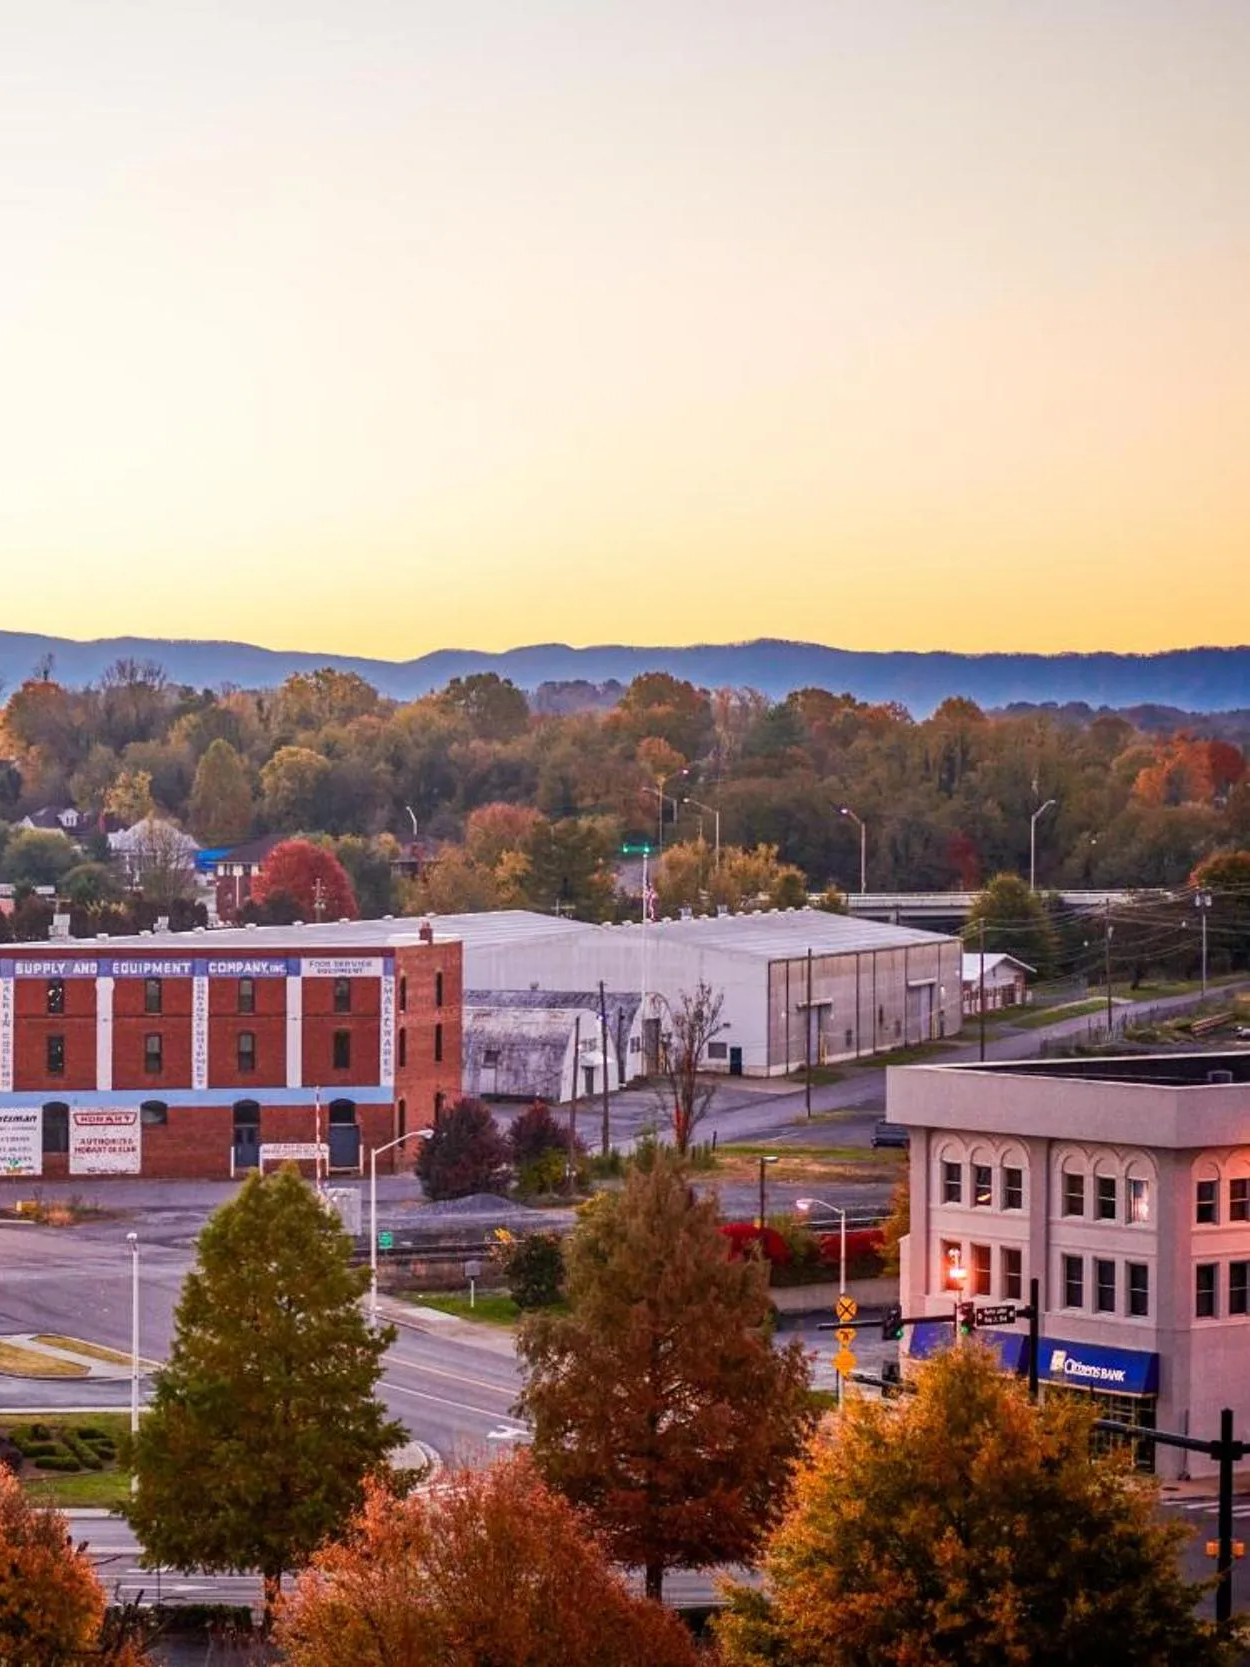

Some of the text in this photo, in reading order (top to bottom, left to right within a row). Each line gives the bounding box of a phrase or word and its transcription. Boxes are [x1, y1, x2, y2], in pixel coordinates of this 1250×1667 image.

[14, 962, 66, 975] SUPPLY
[72, 962, 98, 975] AND
[112, 962, 192, 975] EQUIPMENT
[1064, 1358, 1101, 1378] Citizens
